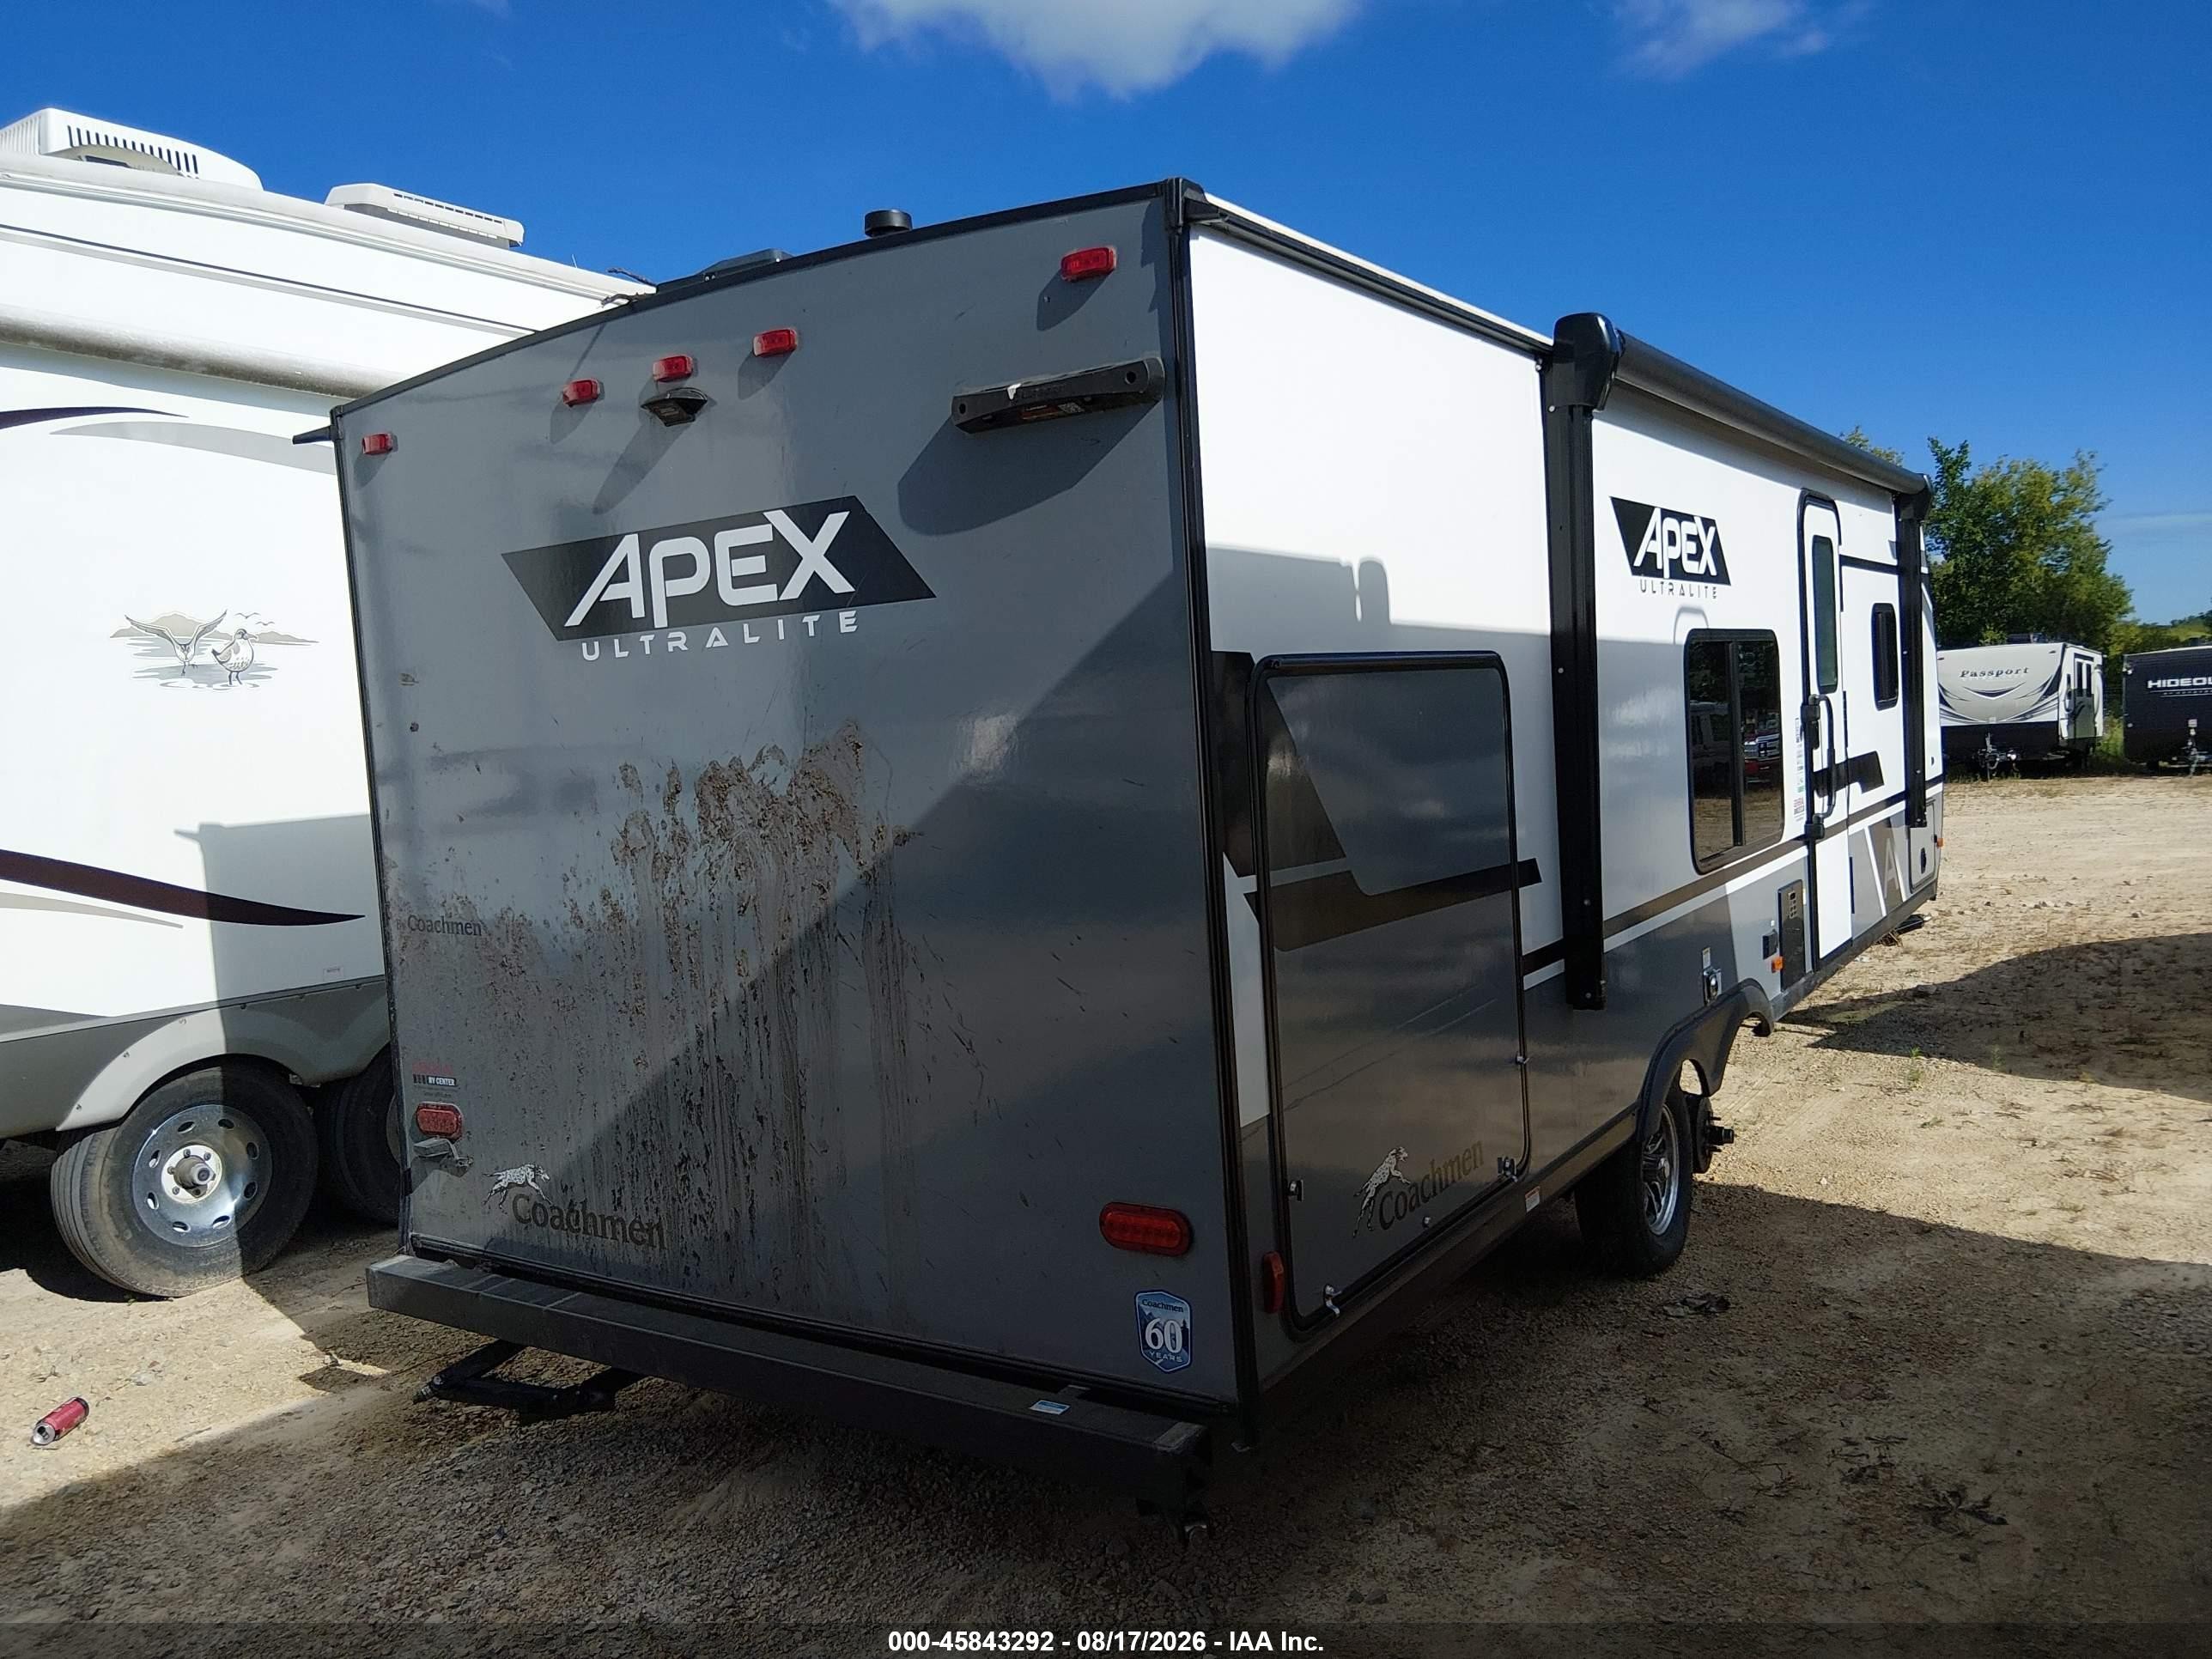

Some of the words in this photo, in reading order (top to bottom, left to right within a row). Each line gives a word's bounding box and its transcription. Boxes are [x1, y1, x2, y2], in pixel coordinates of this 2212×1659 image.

[1632, 507, 1717, 580] APEX
[563, 509, 856, 629] APEX
[1639, 578, 1717, 599] ULTRALITE
[581, 610, 859, 661] ULTRALITE
[1959, 666, 2029, 678] Passport
[407, 914, 483, 936] Coachmen
[435, 1078, 455, 1086] CENTER
[1379, 1140, 1485, 1231] Coachmen
[513, 1194, 666, 1250] Coachmen
[1141, 1298, 1184, 1313] Coachmen
[1145, 1317, 1183, 1354] 60
[1149, 1351, 1183, 1363] YEARS
